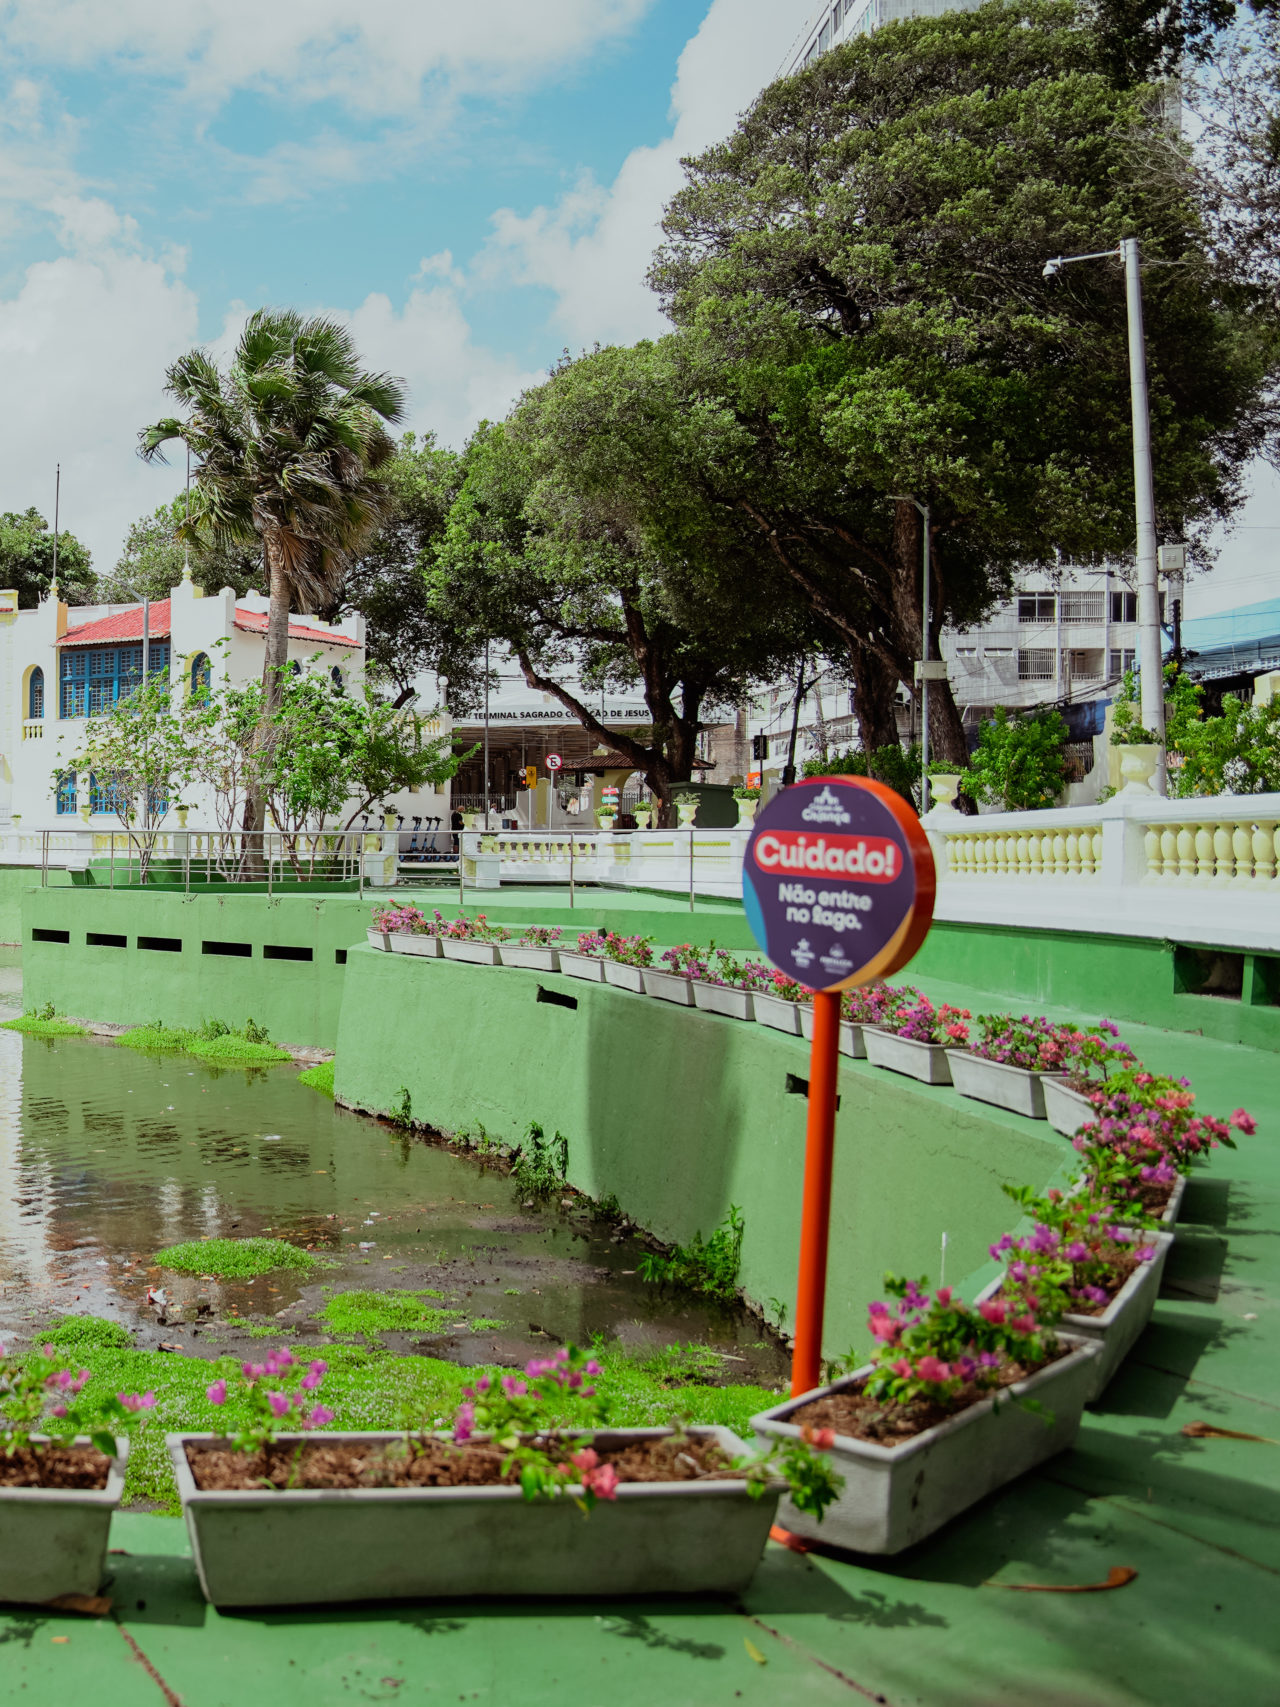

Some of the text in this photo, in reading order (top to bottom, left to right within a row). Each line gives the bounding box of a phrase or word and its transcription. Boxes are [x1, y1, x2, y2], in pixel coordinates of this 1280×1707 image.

[520, 710, 563, 718] SAGRADO
[565, 709, 608, 718] COÇÃO
[624, 709, 650, 717] JESUS
[755, 836, 895, 877] Cuidado!
[778, 882, 873, 912] Não entre
[786, 904, 863, 932] no lago.
